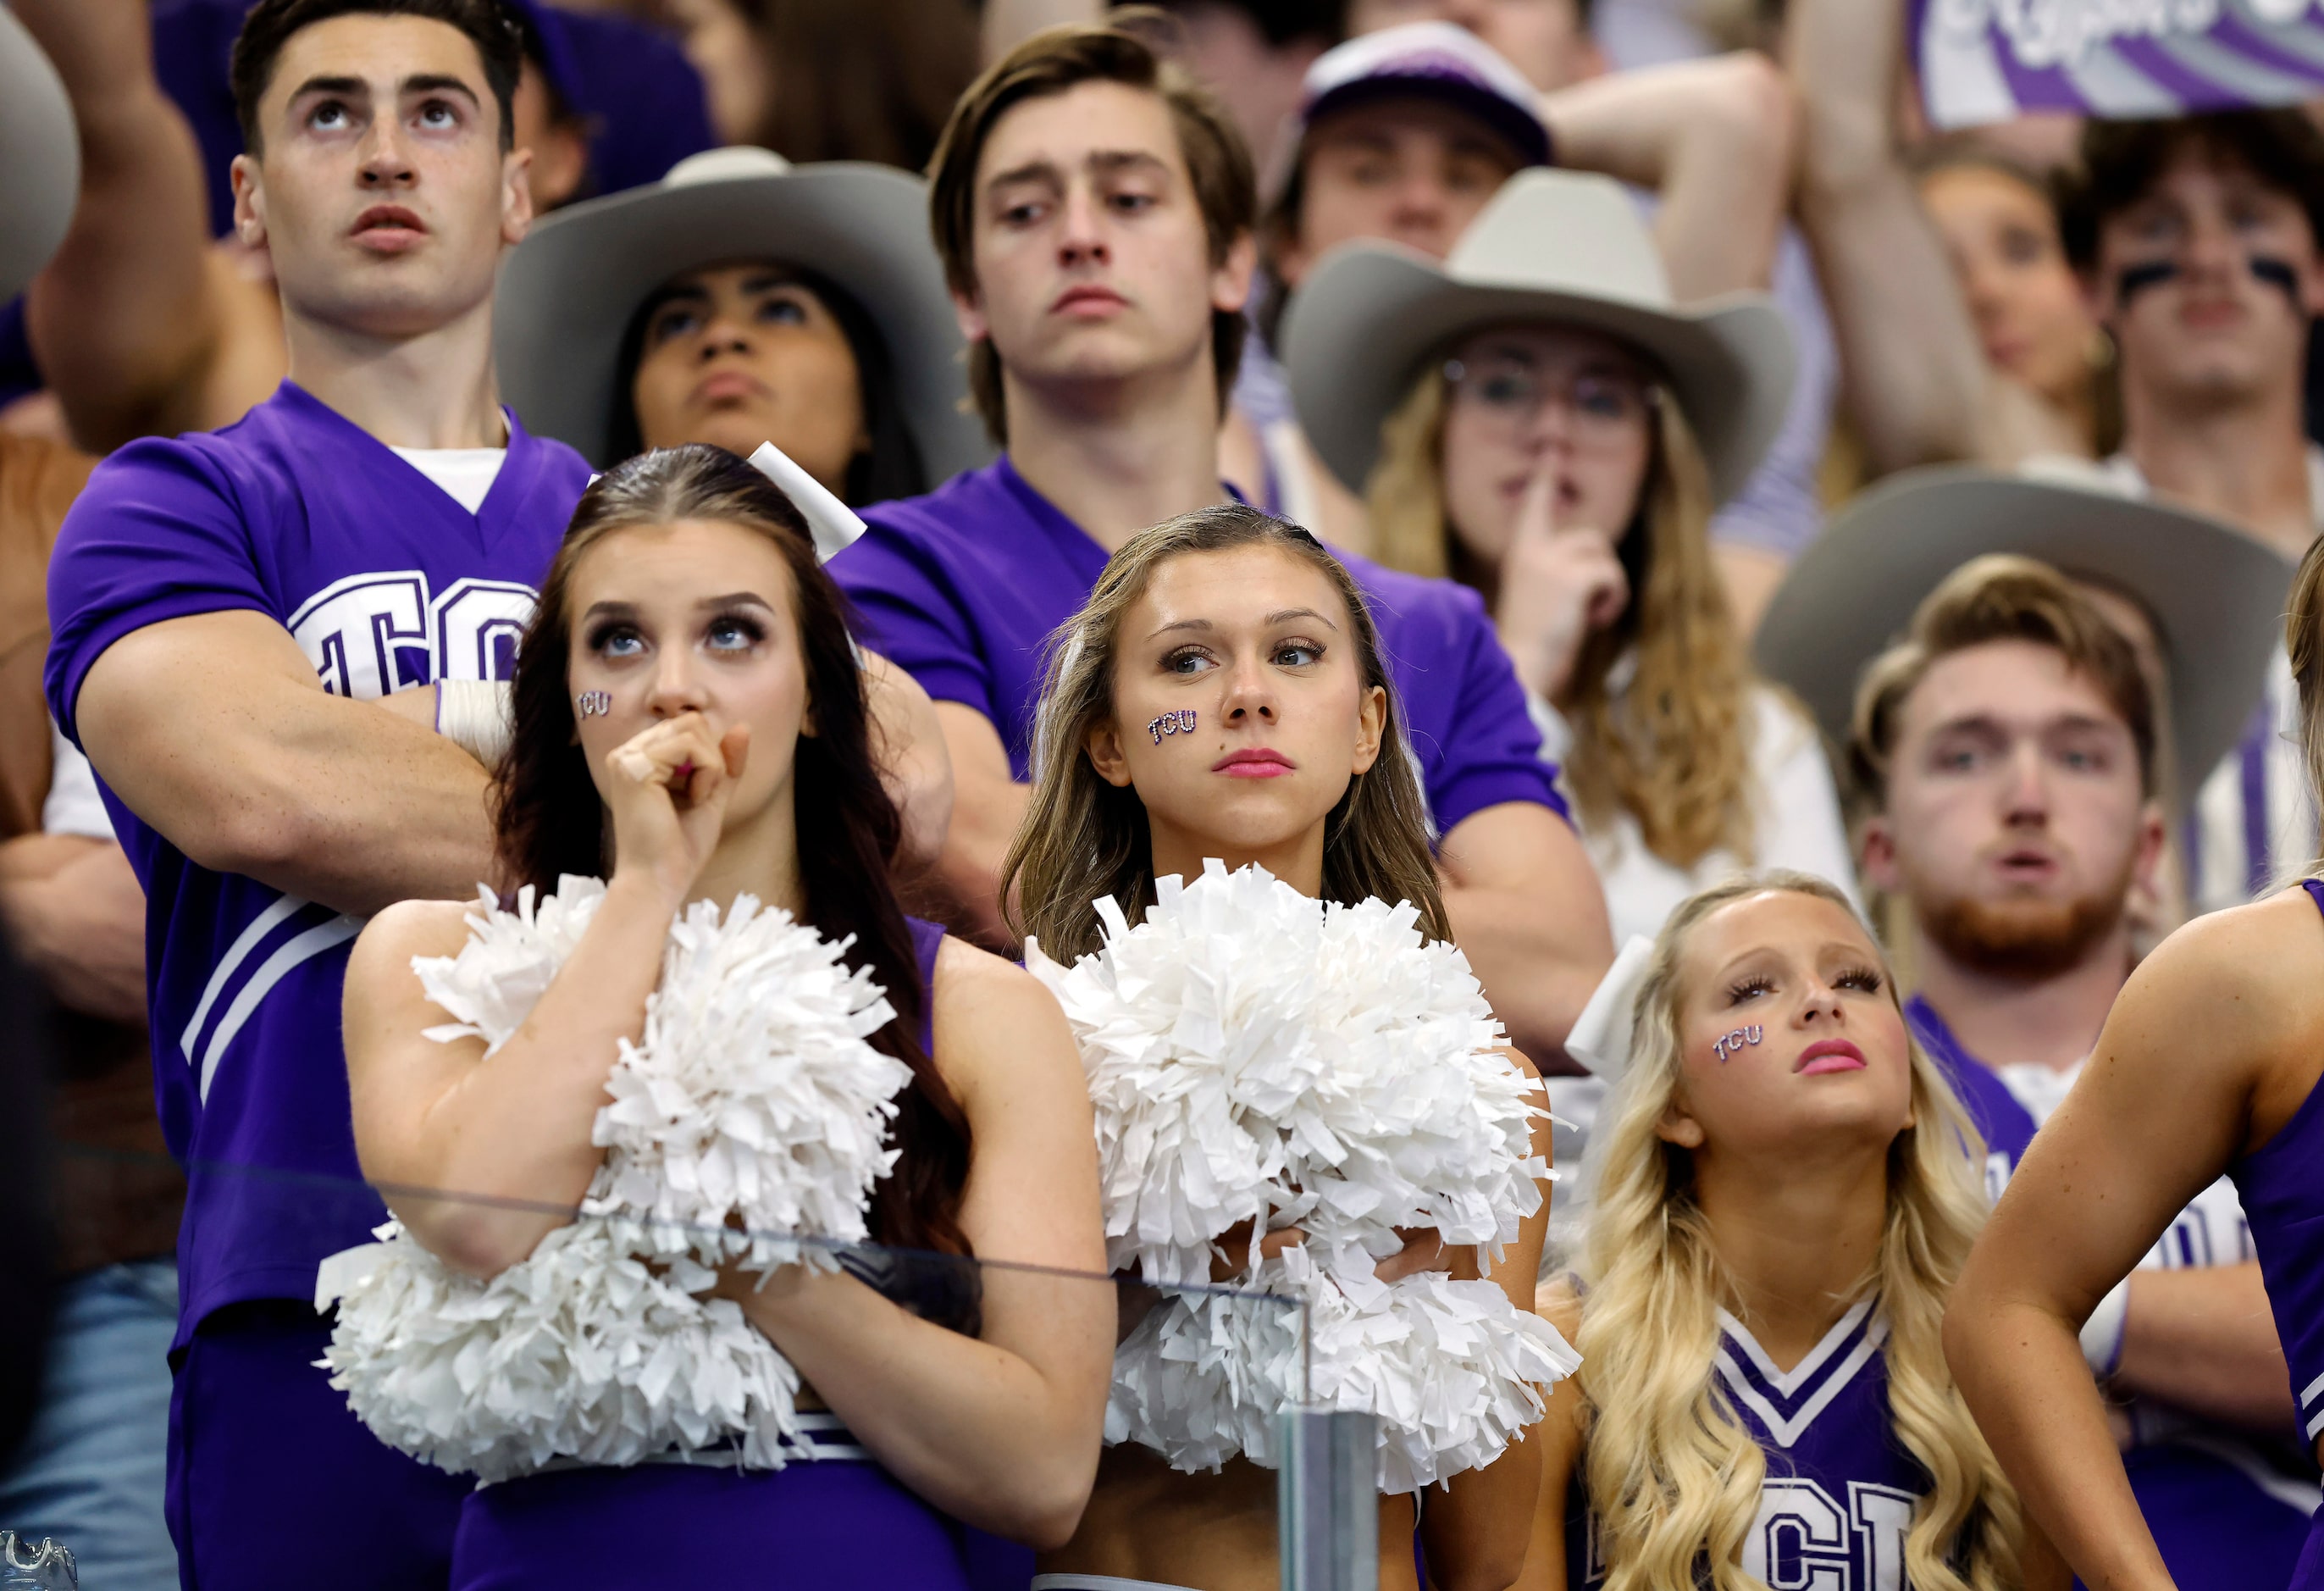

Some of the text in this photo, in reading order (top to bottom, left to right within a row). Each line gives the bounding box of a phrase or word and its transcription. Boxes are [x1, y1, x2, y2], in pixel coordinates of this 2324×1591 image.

[287, 569, 540, 700] TC
[575, 690, 611, 721] TCU
[1148, 710, 1197, 746] TCU
[1713, 1025, 1762, 1062] TCU
